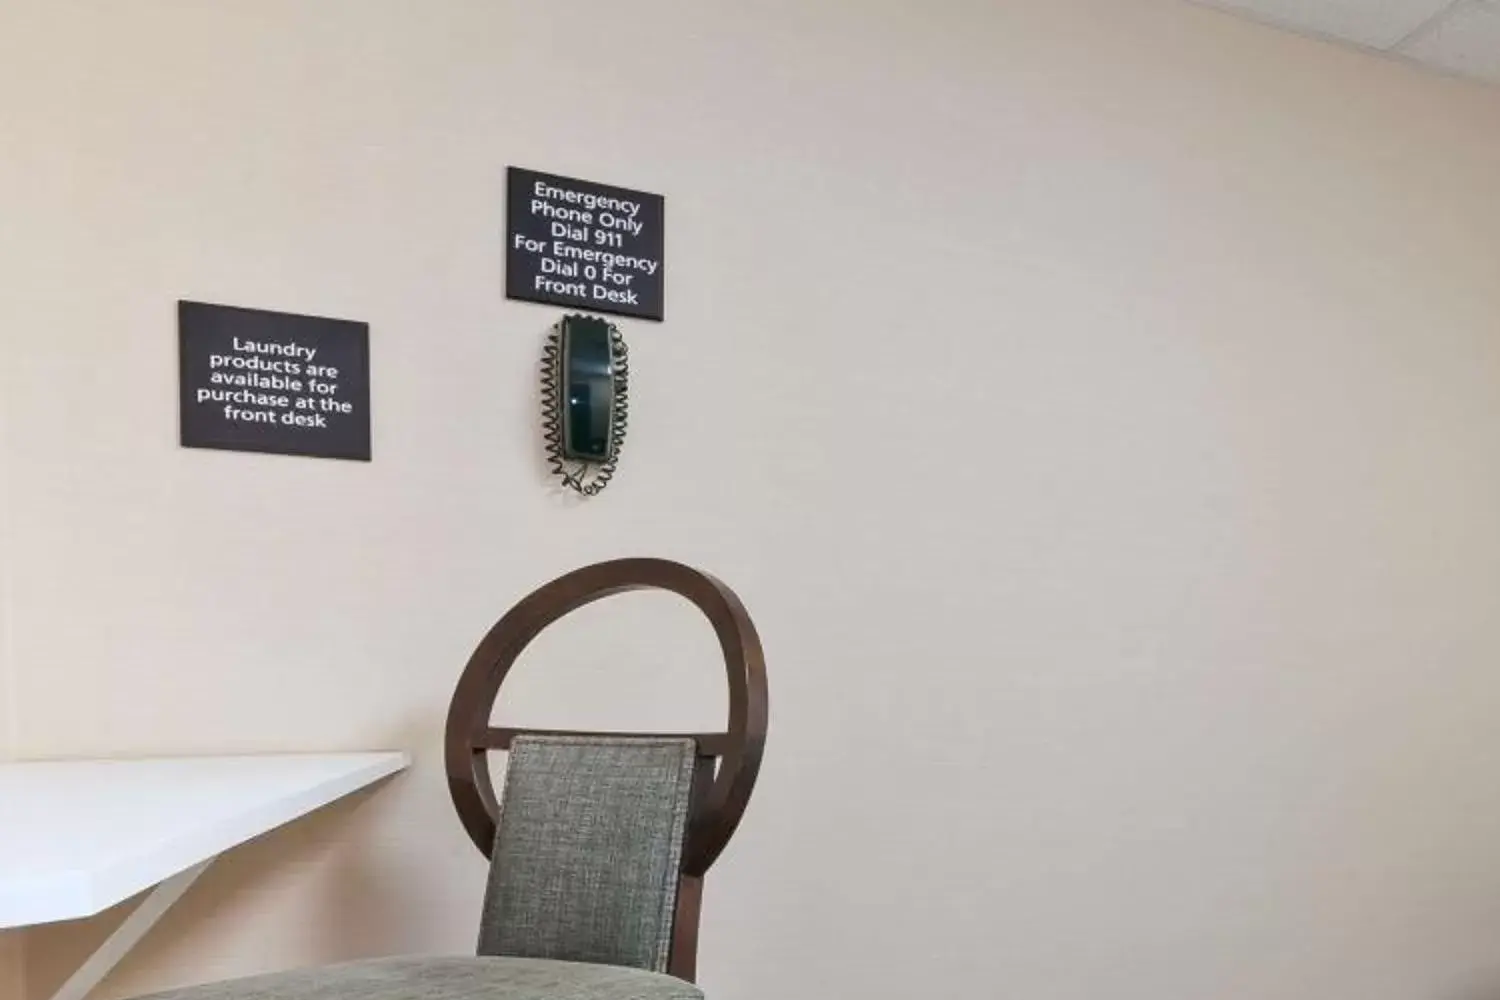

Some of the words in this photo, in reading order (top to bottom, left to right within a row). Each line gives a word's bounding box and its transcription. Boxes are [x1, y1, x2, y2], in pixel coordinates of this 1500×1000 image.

[534, 181, 641, 217] Emergency
[531, 199, 593, 225] Phone
[599, 212, 643, 236] Only
[551, 222, 589, 242] Dial
[595, 229, 623, 247] 911
[514, 234, 547, 253] For
[553, 241, 657, 275] Emergency
[541, 257, 578, 277] Dial
[603, 267, 634, 285] For
[535, 275, 587, 297] Front
[593, 285, 639, 305] Desk
[233, 336, 317, 362] Laundry
[209, 354, 301, 375] products
[306, 364, 339, 378] are
[211, 371, 302, 392] available
[308, 379, 338, 395] for
[197, 388, 289, 408] purchase
[295, 398, 316, 411] at
[320, 398, 353, 414] the
[223, 405, 277, 424] front
[281, 411, 328, 429] desk
